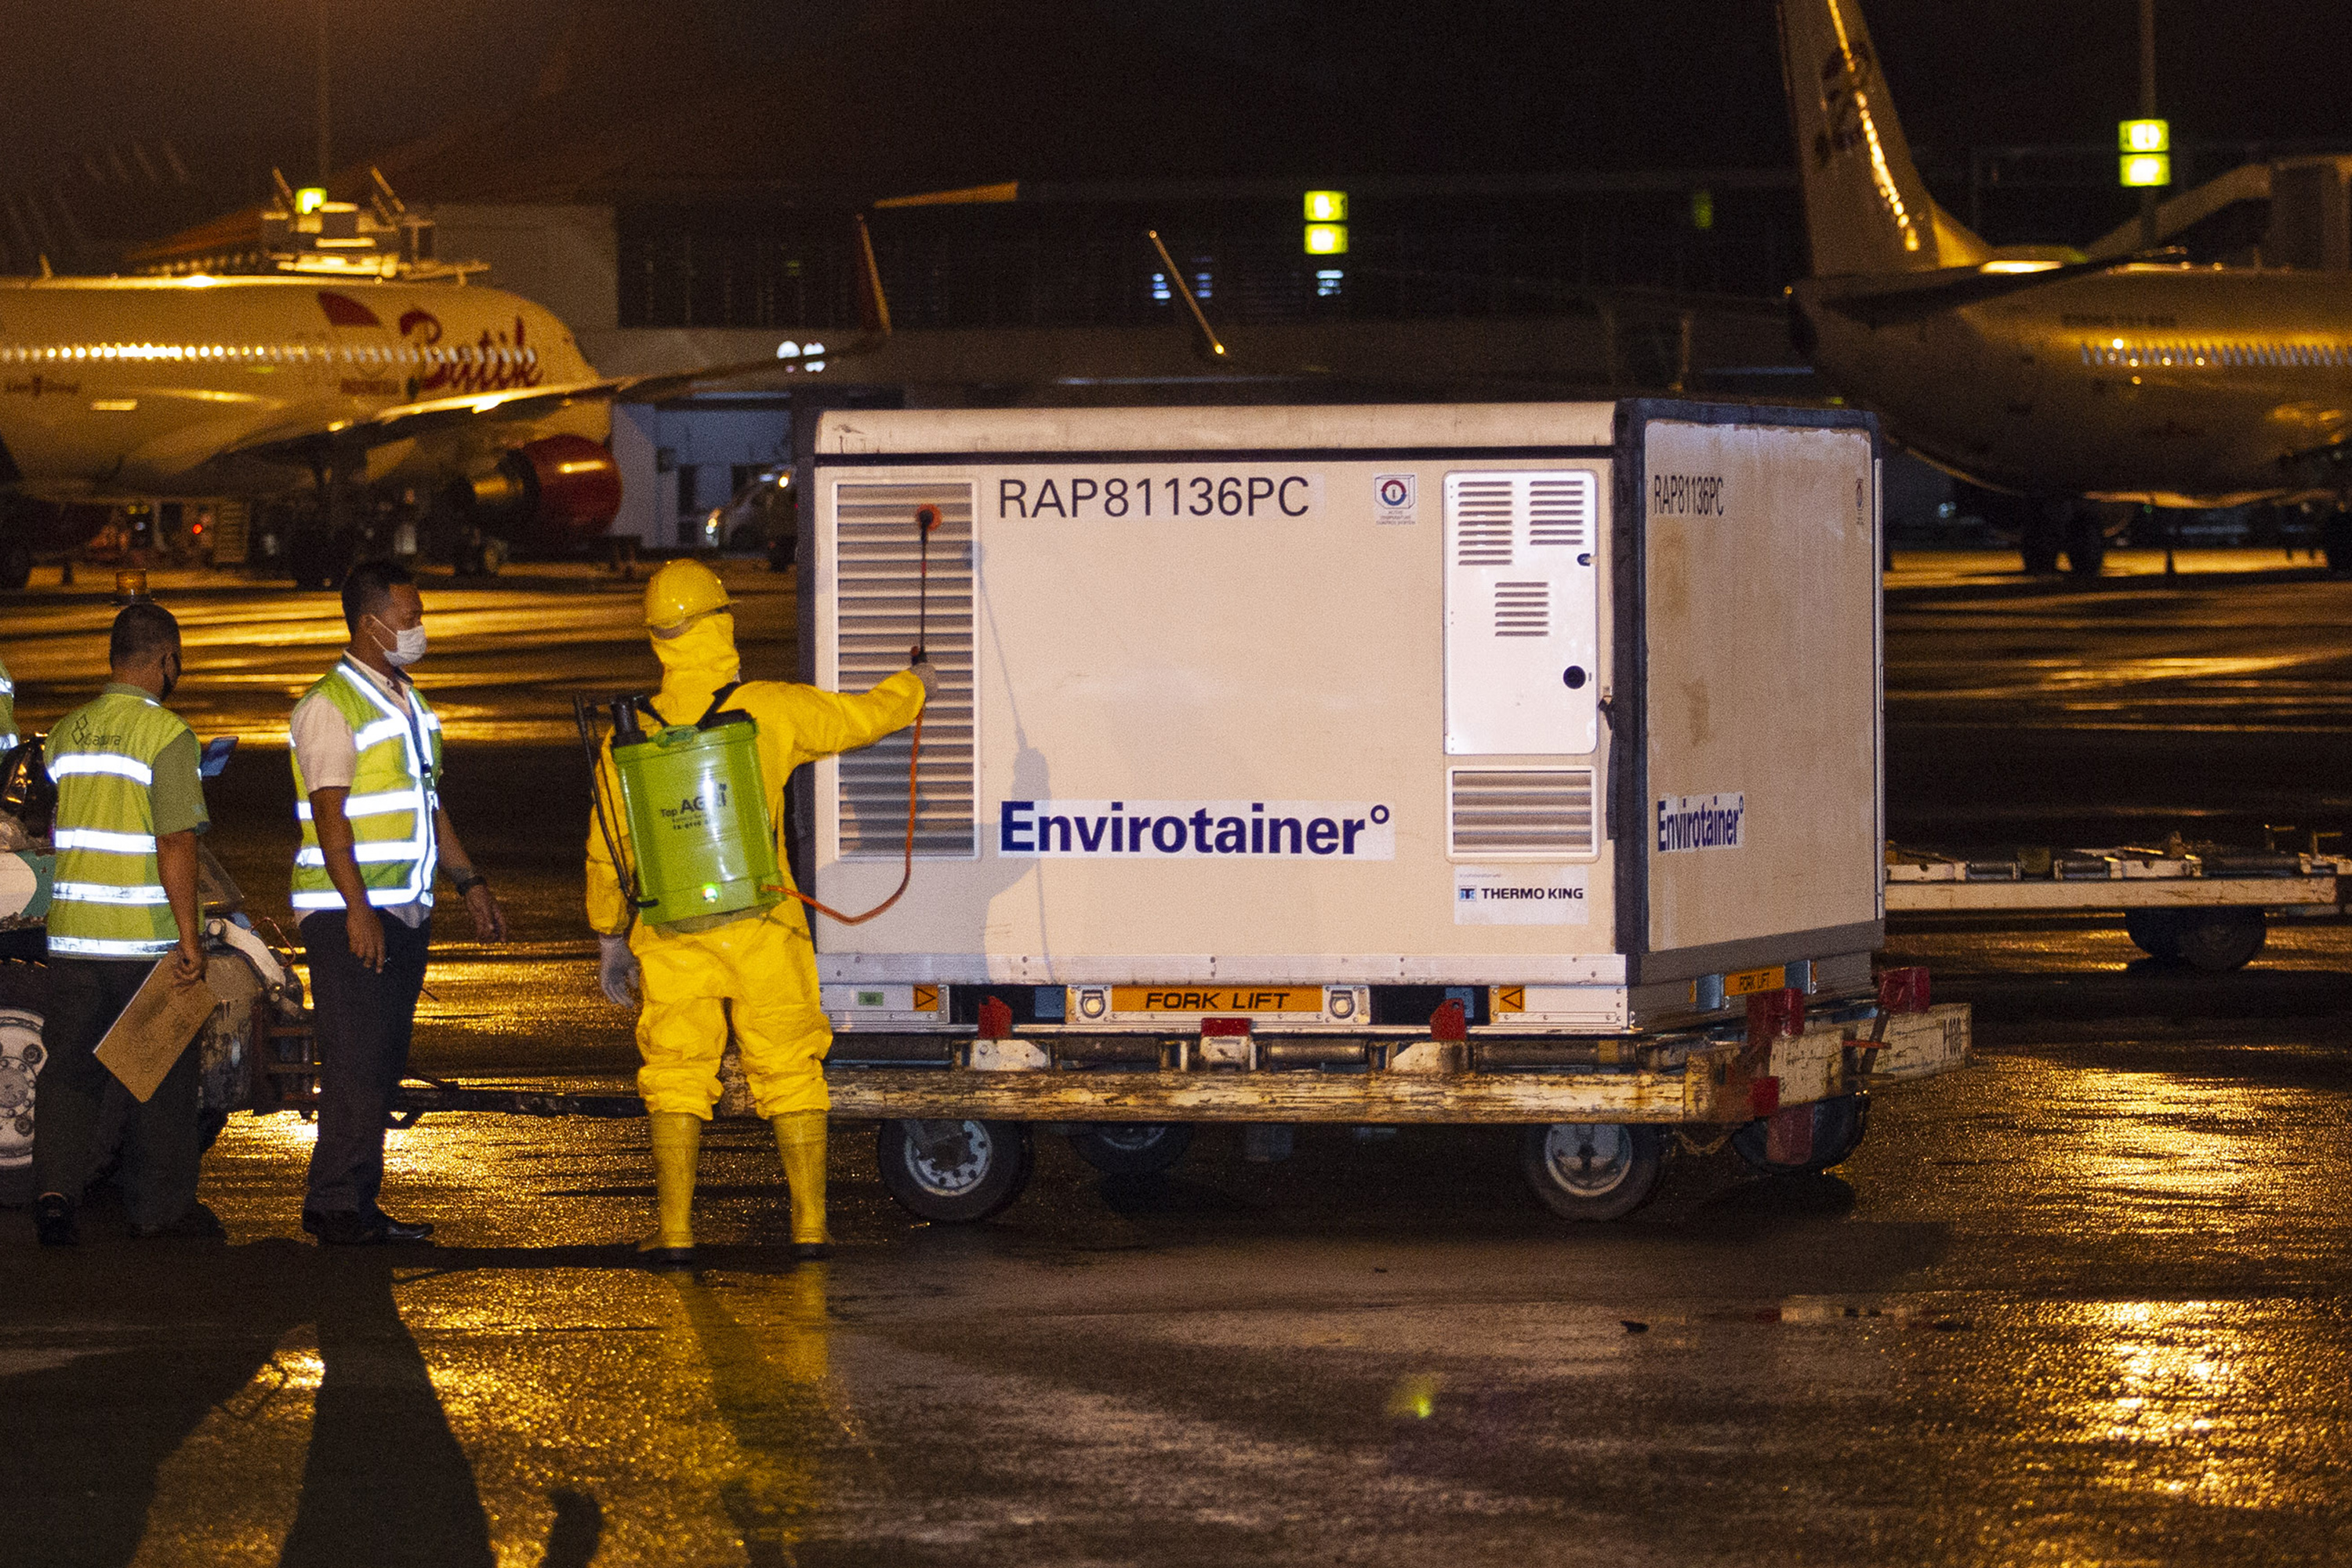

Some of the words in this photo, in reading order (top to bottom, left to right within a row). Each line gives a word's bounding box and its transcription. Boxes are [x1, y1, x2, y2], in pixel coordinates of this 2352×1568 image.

[999, 476, 1310, 518] RAP81136PC
[1653, 474, 1724, 517] RAP81136PC
[680, 790, 727, 815] AGI
[1481, 887, 1545, 900] THERMO
[1548, 887, 1584, 900] KING
[1145, 992, 1221, 1010] FORK
[1231, 992, 1290, 1010] LIFT
